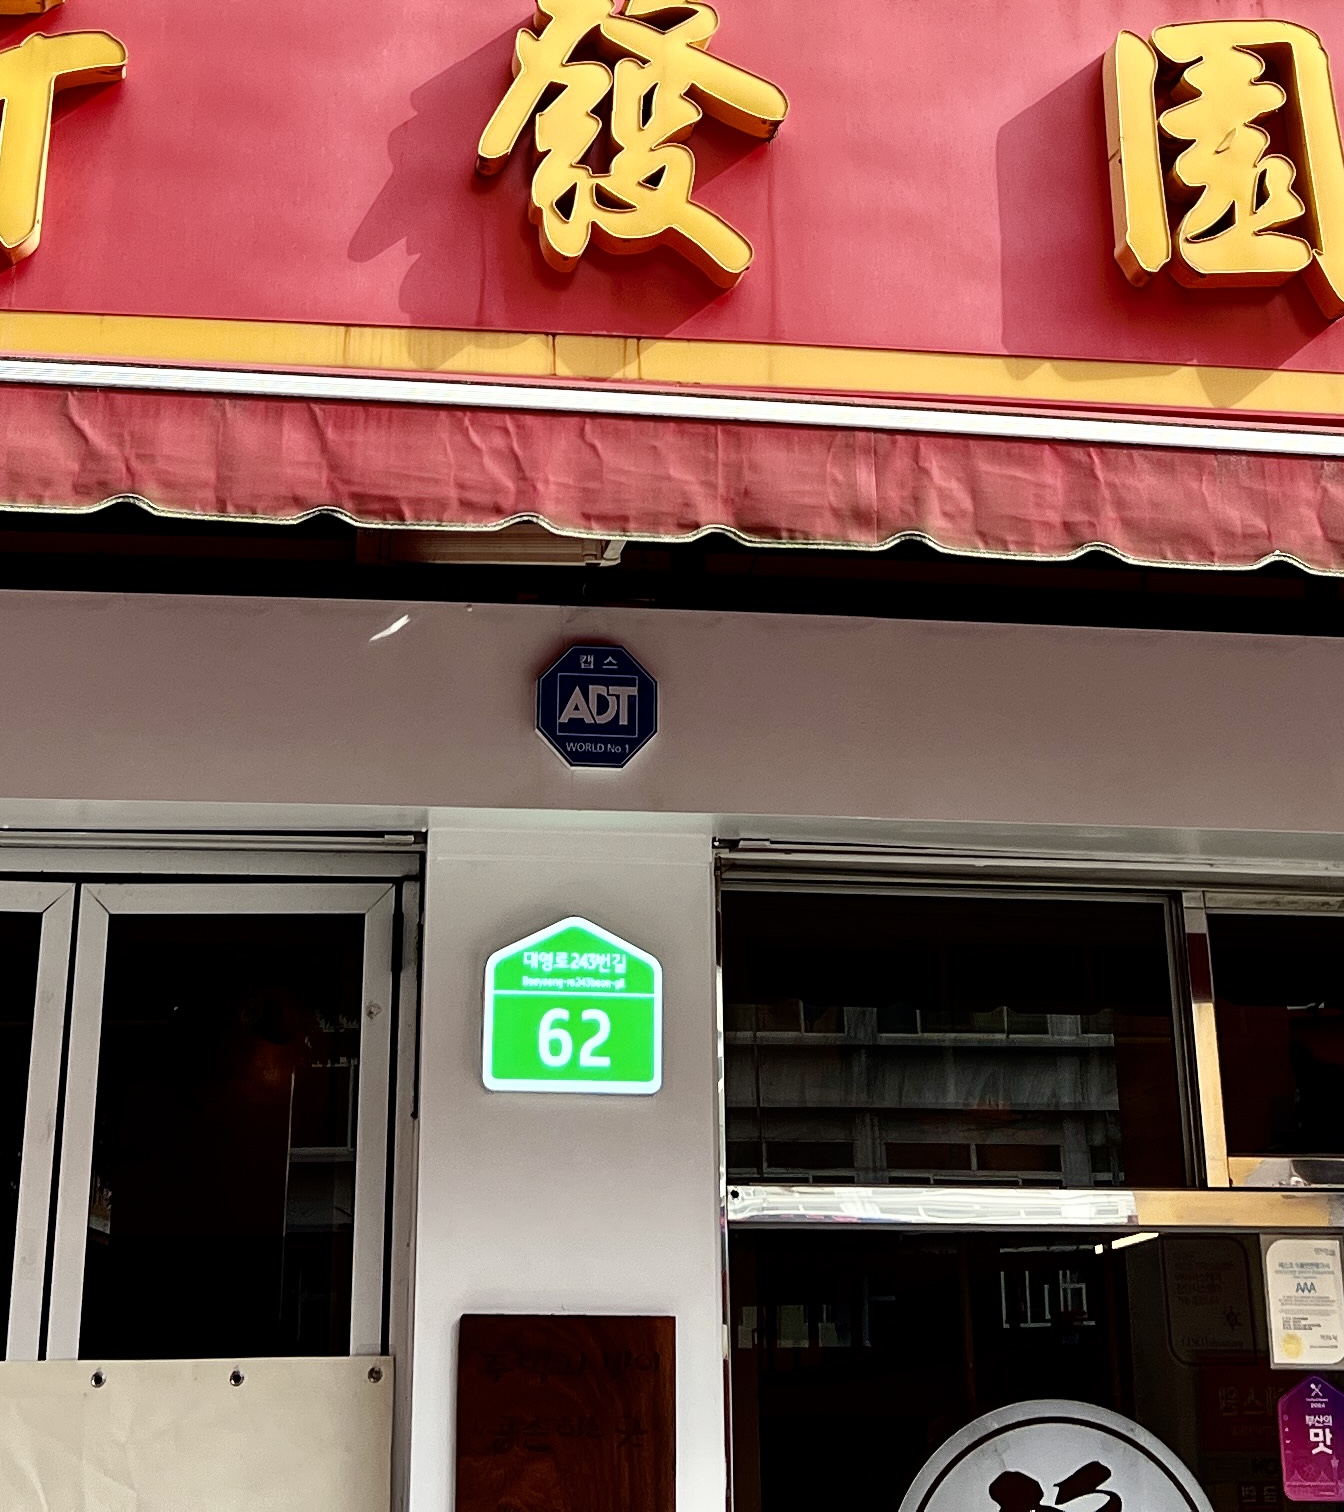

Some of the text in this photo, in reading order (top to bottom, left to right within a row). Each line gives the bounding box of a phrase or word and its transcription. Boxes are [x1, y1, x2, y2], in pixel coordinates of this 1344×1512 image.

[558, 684, 638, 725] ADT
[566, 742, 605, 753] WORLD
[538, 1007, 612, 1068] 62
[1309, 1428, 1333, 1455] 맛
